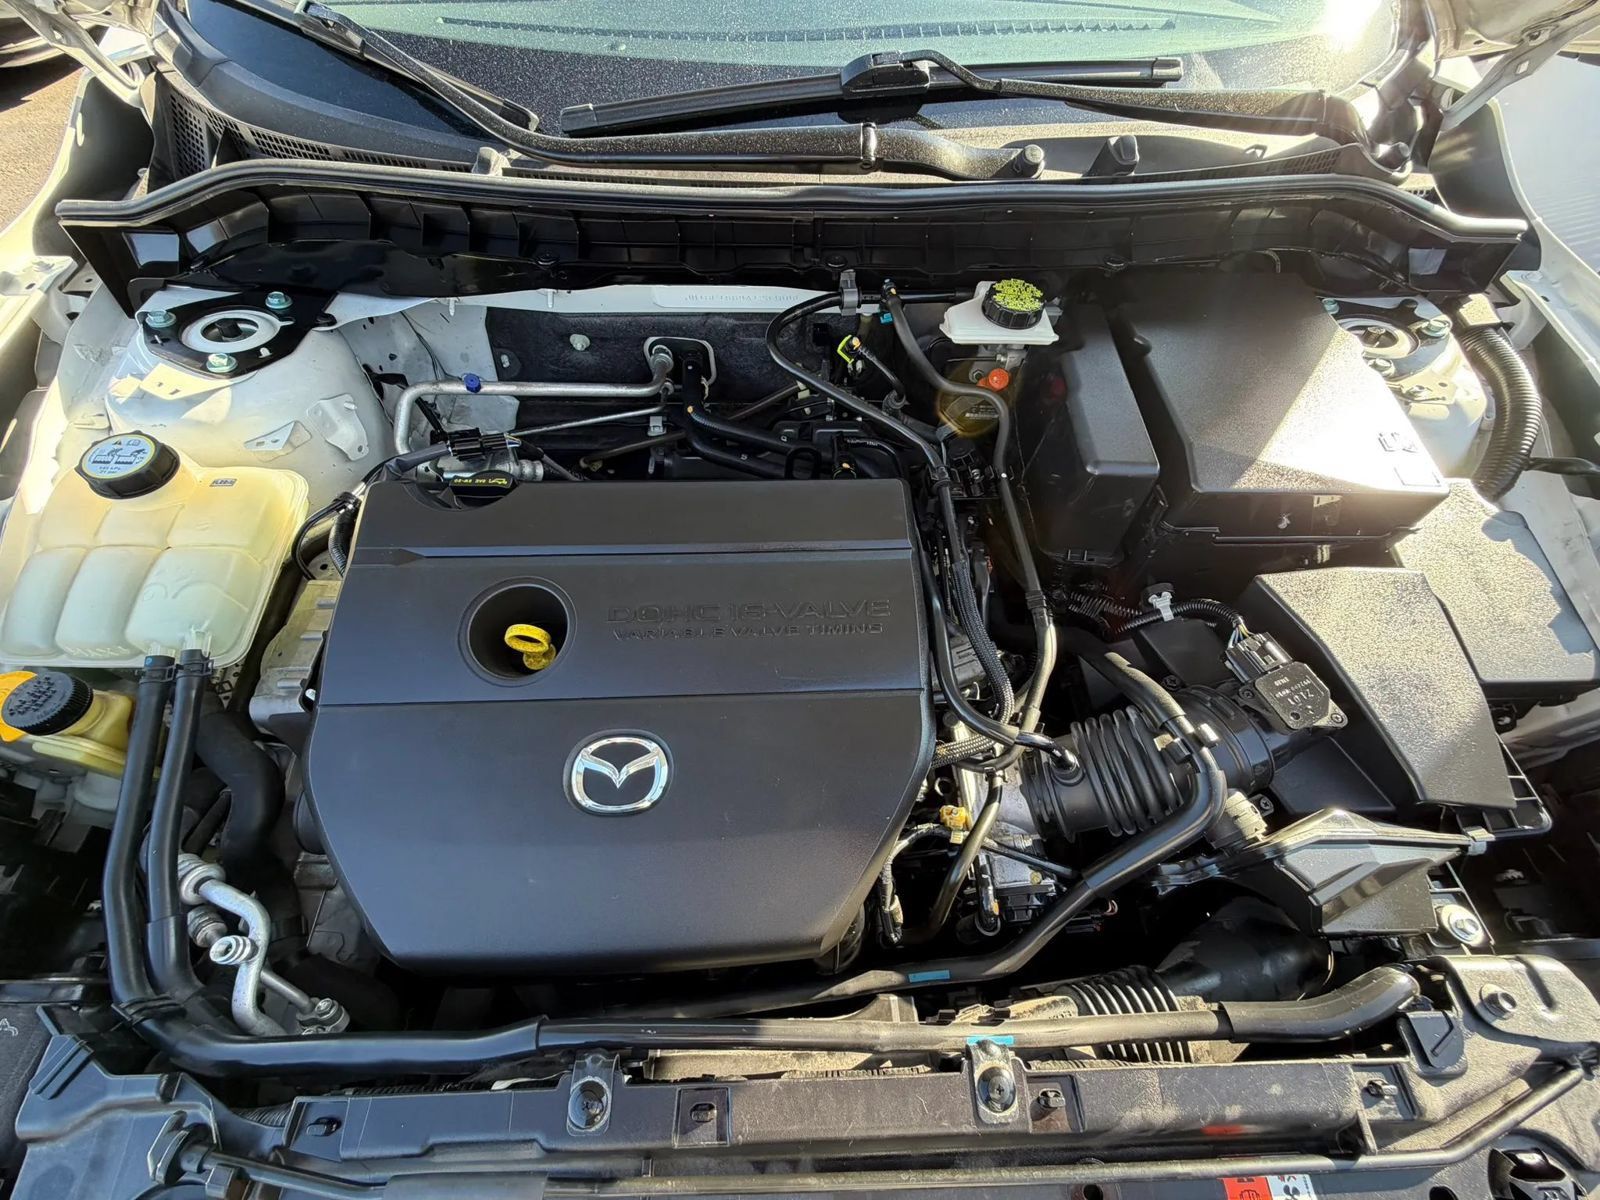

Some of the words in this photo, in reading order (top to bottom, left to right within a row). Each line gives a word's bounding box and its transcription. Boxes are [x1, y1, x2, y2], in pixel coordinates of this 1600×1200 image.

[606, 603, 721, 623] DOHC
[730, 600, 891, 621] 16-VALVE
[612, 627, 726, 641] VARIABLE
[730, 624, 800, 639] VALVE
[806, 621, 883, 636] TIMING
